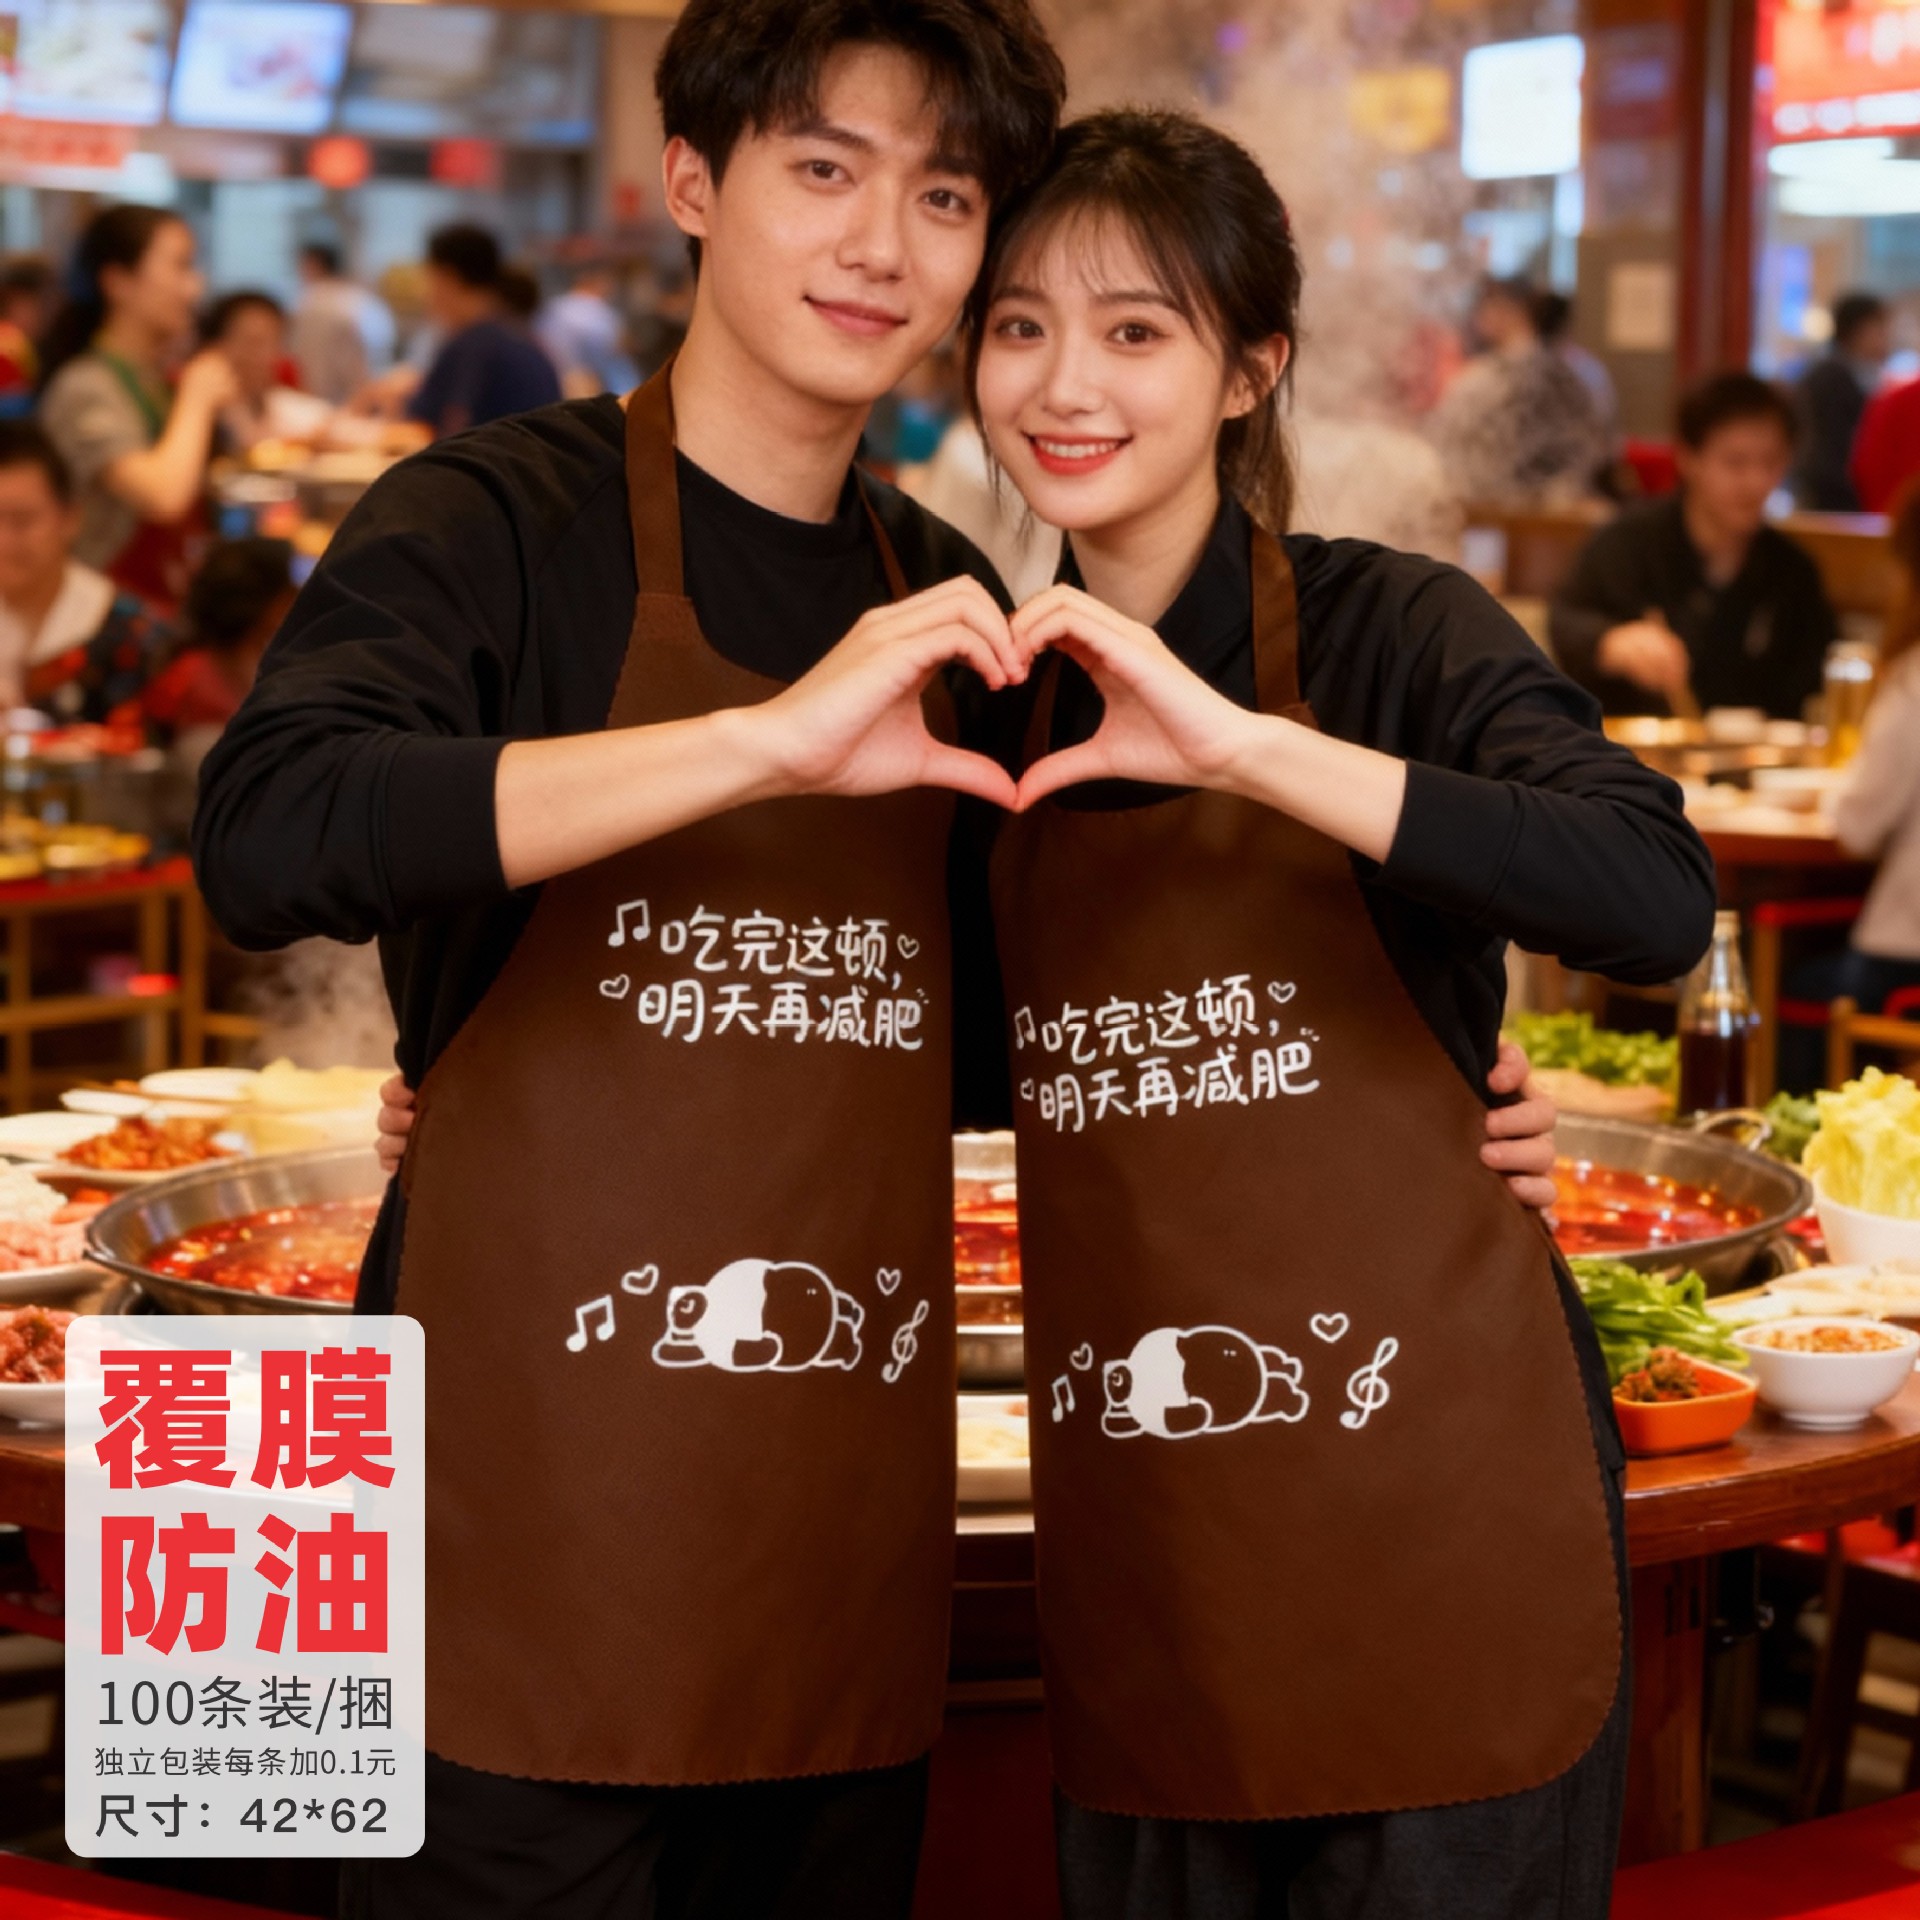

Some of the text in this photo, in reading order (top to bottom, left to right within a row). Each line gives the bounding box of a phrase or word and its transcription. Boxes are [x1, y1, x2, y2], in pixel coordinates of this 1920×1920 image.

[637, 978, 923, 1051] 明天再减肥
[1039, 1041, 1320, 1133] 明天再减肥
